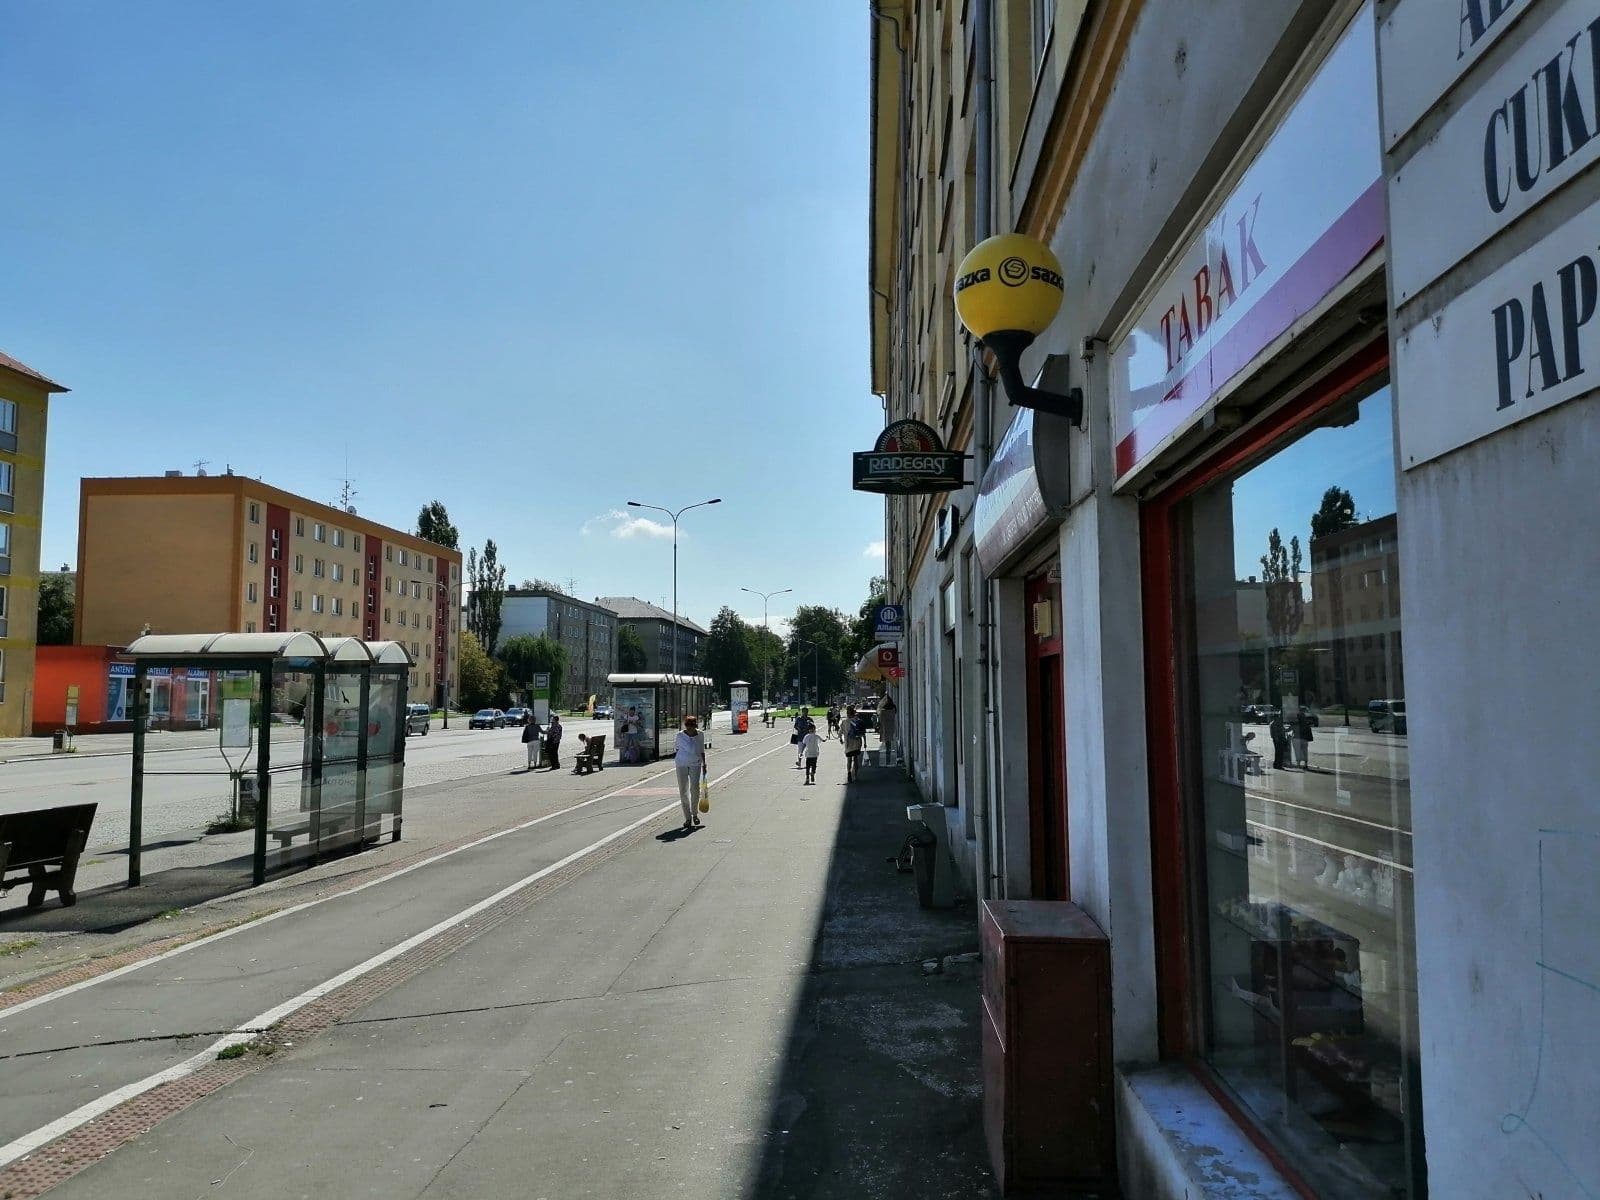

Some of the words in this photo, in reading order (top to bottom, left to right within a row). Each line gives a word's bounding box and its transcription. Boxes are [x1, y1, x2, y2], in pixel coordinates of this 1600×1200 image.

[956, 267, 991, 293] azka
[1161, 192, 1269, 375] TABÁK
[1491, 245, 1600, 412] PAP
[869, 457, 949, 475] RADEGAST
[877, 624, 901, 632] Allianz
